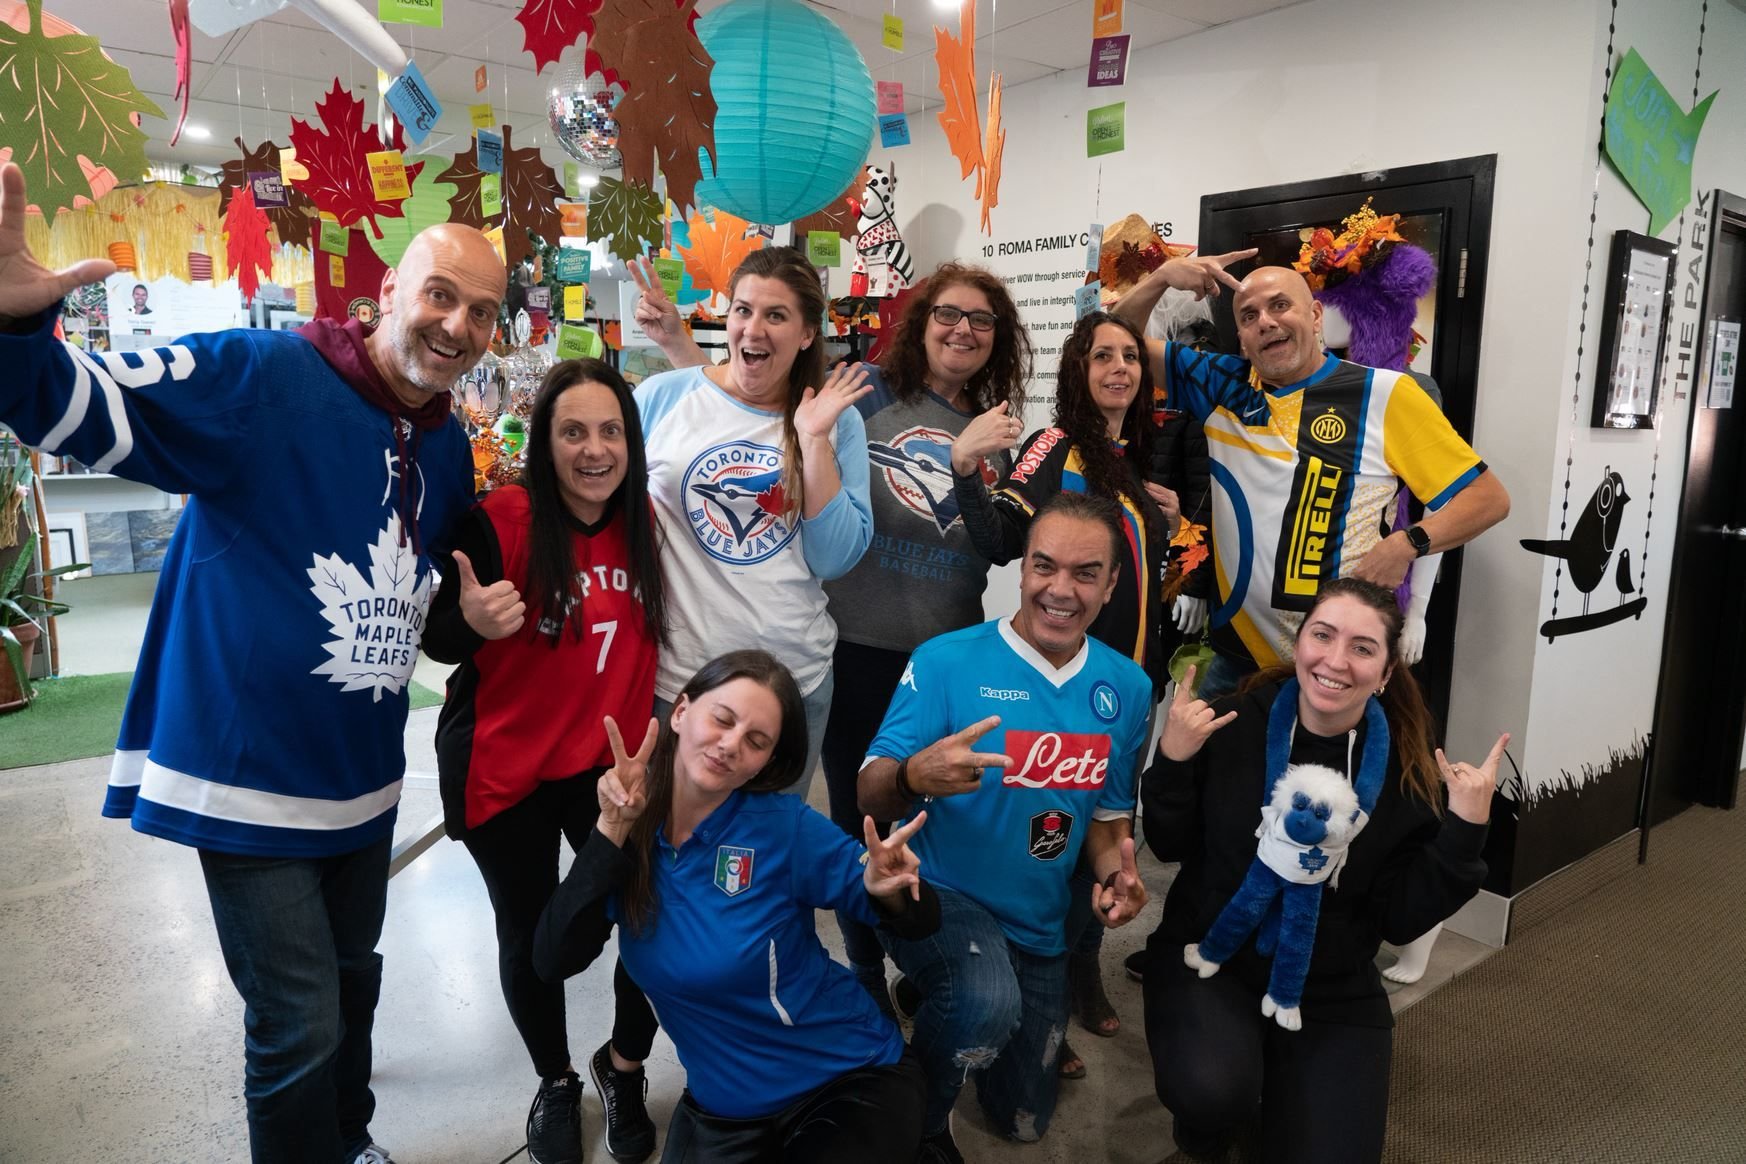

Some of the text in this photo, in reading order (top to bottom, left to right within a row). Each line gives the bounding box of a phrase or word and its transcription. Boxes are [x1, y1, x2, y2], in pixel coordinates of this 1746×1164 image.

[1096, 70, 1119, 81] IDEAS
[981, 244, 994, 258] 10
[998, 239, 1033, 257] ROMA
[1035, 233, 1078, 252] FAMILY
[1016, 272, 1034, 283] WOW
[1034, 271, 1060, 283] through
[1061, 268, 1086, 280] service
[1016, 298, 1029, 308] and
[1030, 297, 1041, 307] live
[1042, 296, 1049, 306] in
[1673, 189, 1711, 406] THE PARK
[1031, 321, 1047, 331] have
[1048, 320, 1059, 330] fun
[1060, 320, 1073, 330] and
[1040, 345, 1057, 355] team
[696, 450, 778, 479] TORONTO
[689, 507, 788, 558] BLUE JAYS
[873, 534, 971, 567] BLUE JAYS
[880, 556, 953, 582] BASEBALL
[339, 597, 423, 631] TORONTO
[355, 623, 413, 646] MAPLE
[351, 645, 409, 667] LEAFS
[592, 620, 618, 673] 7
[980, 687, 1030, 701] Kappa
[1099, 691, 1114, 713] N
[1003, 733, 1109, 788] Lete
[722, 848, 749, 857] ITALIA
